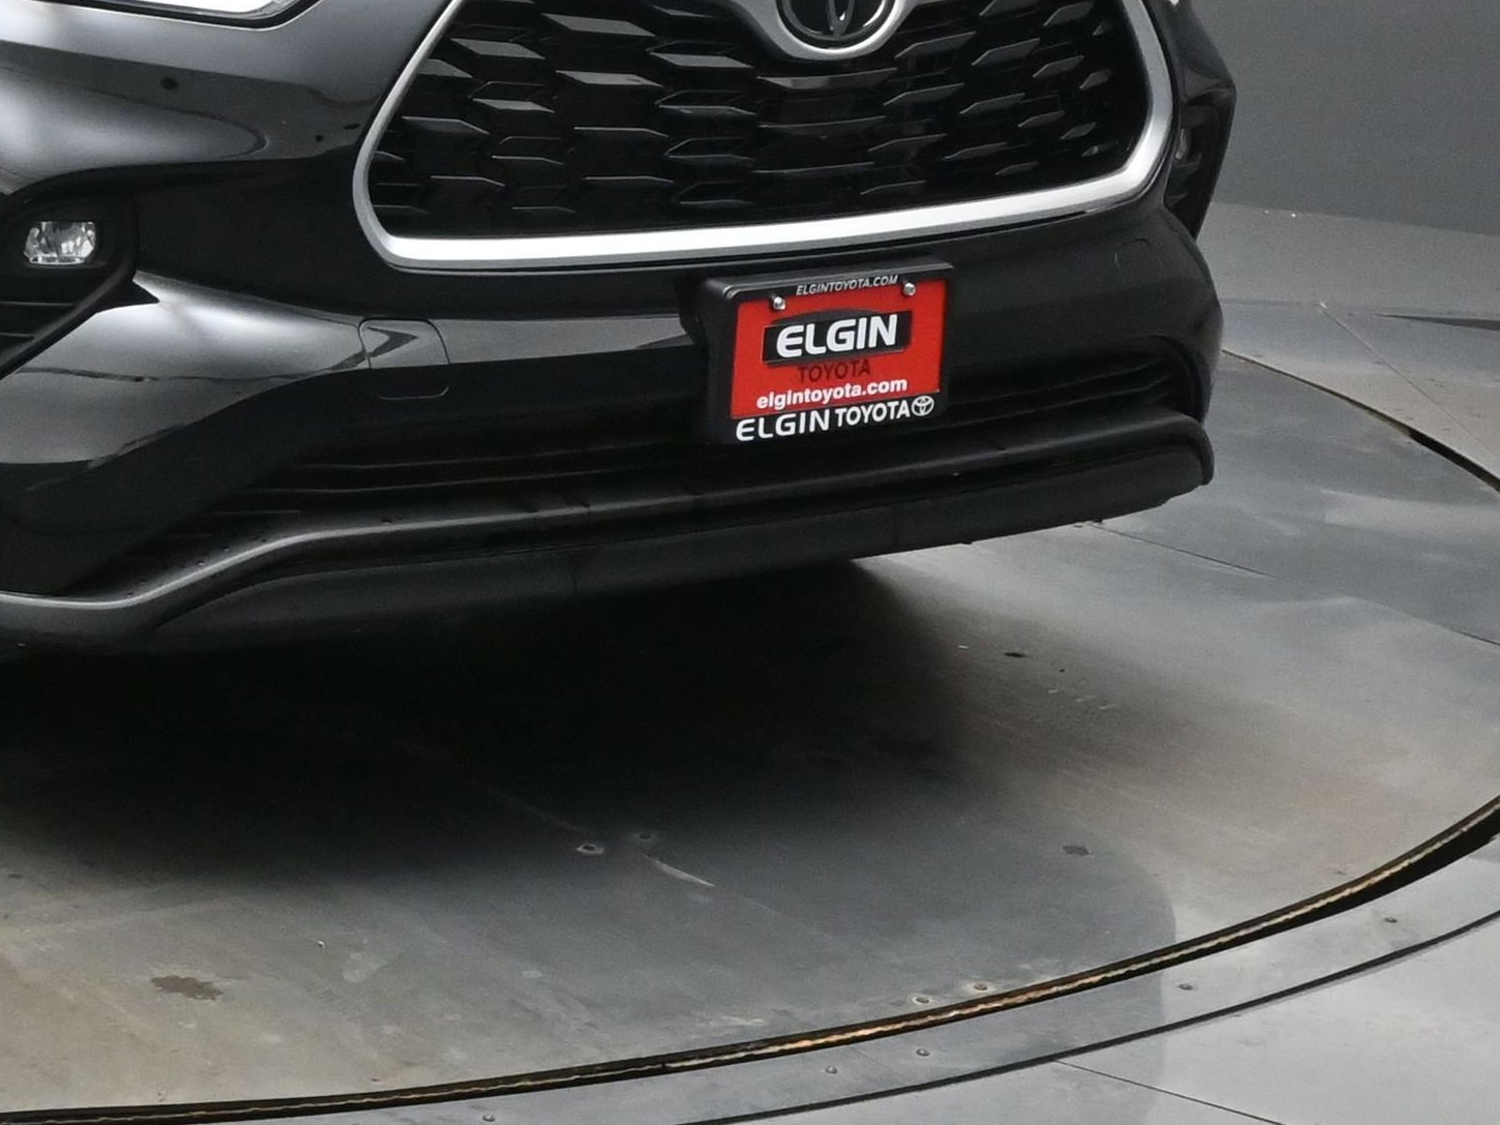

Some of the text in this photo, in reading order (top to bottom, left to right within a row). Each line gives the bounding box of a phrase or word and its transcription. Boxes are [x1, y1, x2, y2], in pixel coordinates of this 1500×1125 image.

[796, 275, 899, 296] ELGINTOYOTA.COM
[776, 314, 897, 358] ELGIN
[798, 360, 870, 383] TOYOTA
[756, 378, 908, 410] elgintoyota.com
[736, 400, 910, 441] ELGIN TOYOTA
